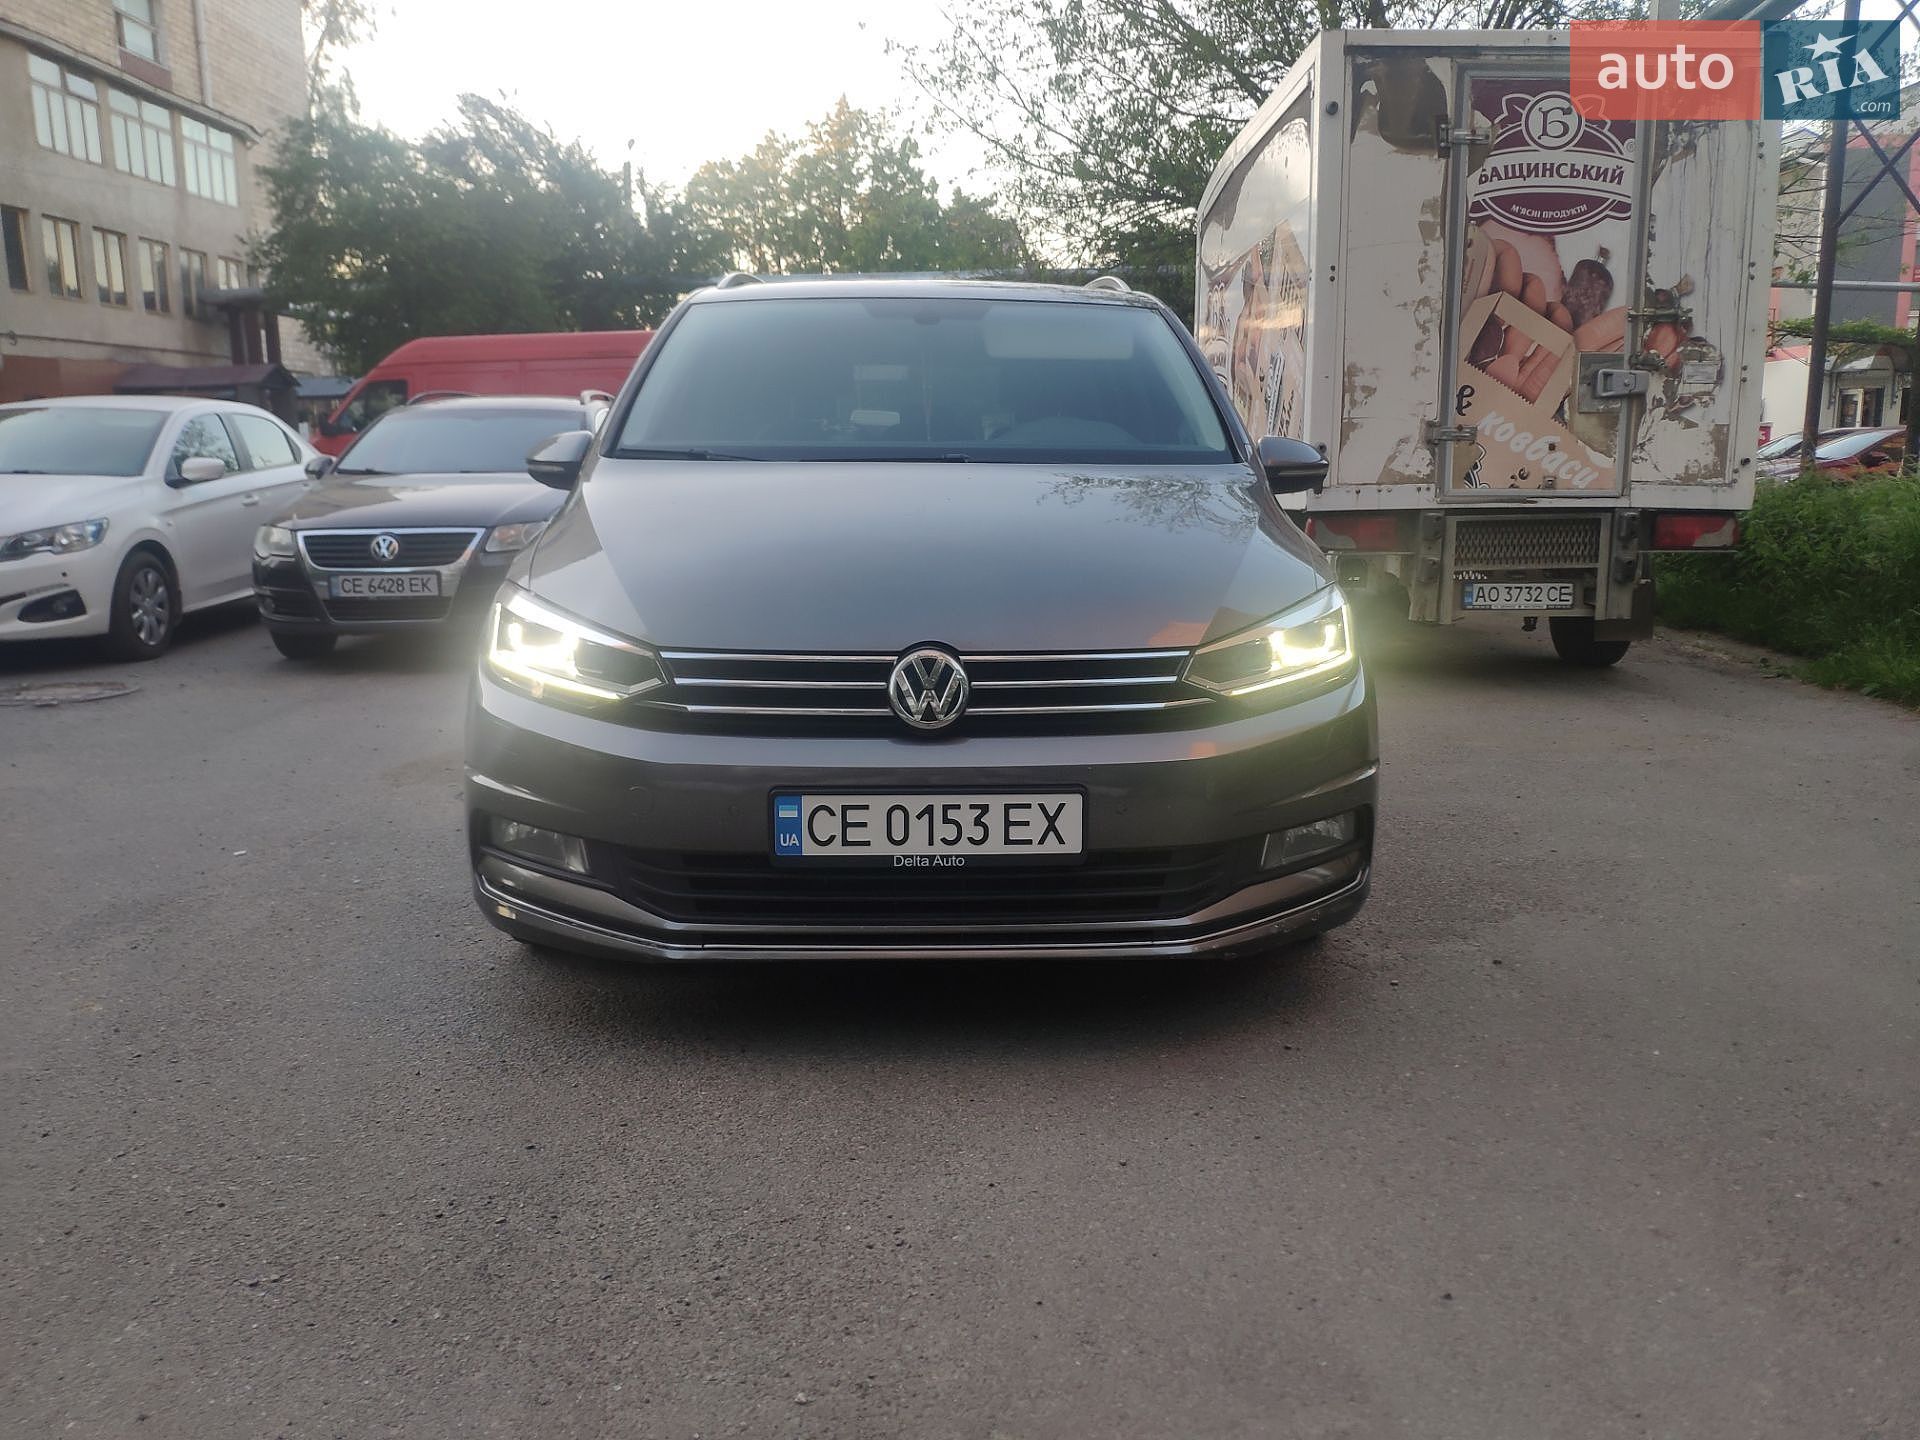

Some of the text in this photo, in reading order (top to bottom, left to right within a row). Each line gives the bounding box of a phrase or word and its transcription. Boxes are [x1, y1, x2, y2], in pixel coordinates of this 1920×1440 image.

[1478, 161, 1625, 187] БАЩИНСЬКИЙ
[1542, 203, 1588, 219] ПРОДУКТИ
[341, 577, 432, 594] CE 6428 EK
[1475, 586, 1500, 602] AO
[1504, 586, 1543, 602] 3732
[1547, 586, 1570, 602] CE
[808, 802, 1066, 847] CE 0153 EX
[780, 833, 800, 847] UA
[893, 855, 965, 868] Delta Auto
